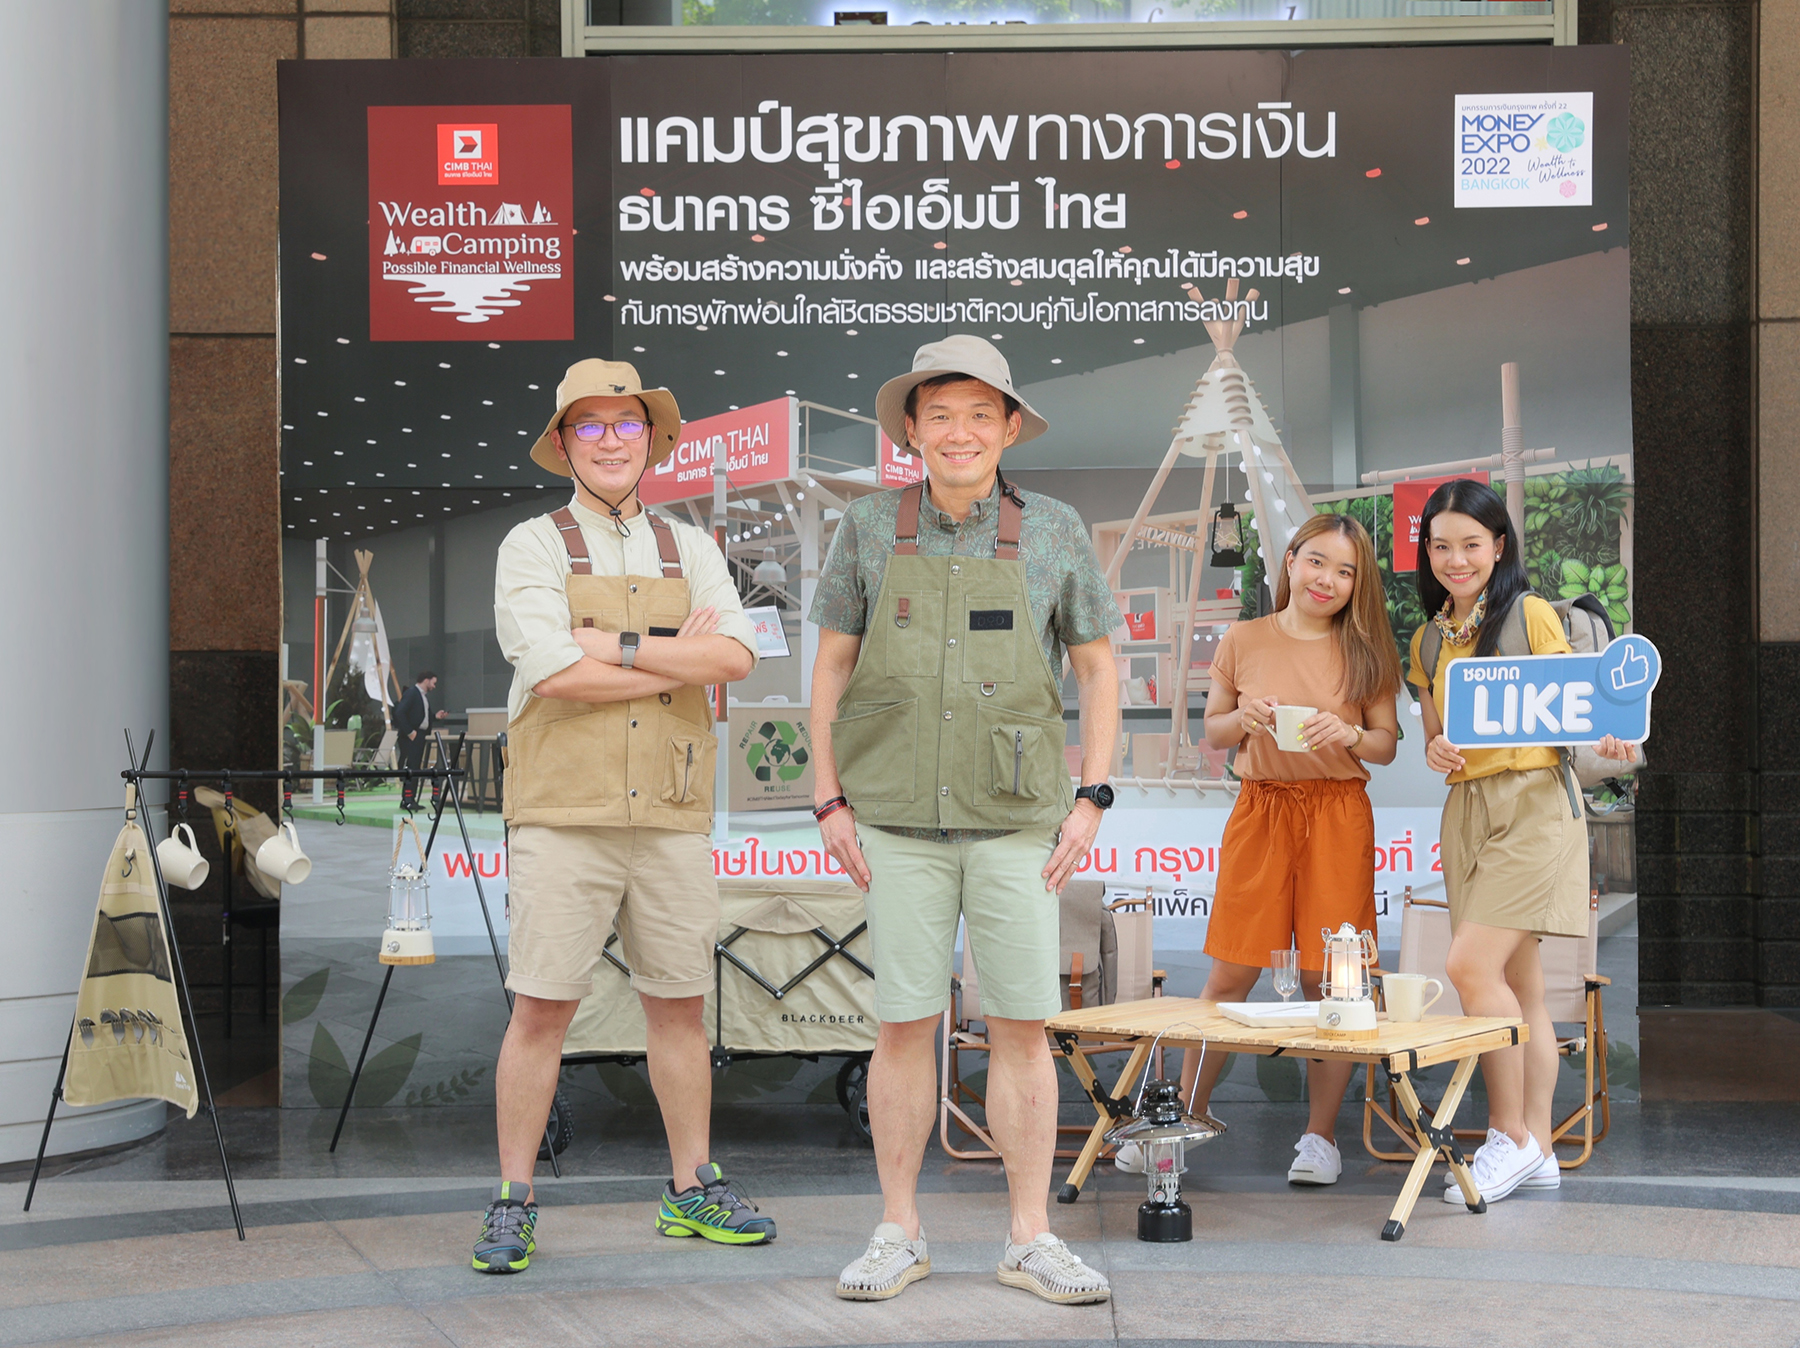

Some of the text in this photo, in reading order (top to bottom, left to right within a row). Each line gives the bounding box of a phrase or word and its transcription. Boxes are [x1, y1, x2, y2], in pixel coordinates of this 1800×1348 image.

[1462, 113, 1545, 132] MONEY
[620, 100, 1336, 180] แคมป์สุขภาพทางการเงิน
[1461, 133, 1531, 153] EXPO
[444, 162, 493, 171] CIMB THAI
[1461, 157, 1510, 175] 2022
[1528, 154, 1577, 172] Wealth to
[1461, 178, 1530, 190] BANGKOK
[1538, 168, 1587, 183] Wellness
[619, 177, 1126, 231] ธนาคาร ซีไอเอ็มบี ไทย
[378, 201, 487, 227] Wealth
[442, 232, 561, 260] Camping
[382, 260, 562, 274] Possible Financial Wellness
[620, 248, 903, 281] พร้อมสร้างความมั่งคั่ง
[727, 422, 769, 453] THAI
[677, 466, 707, 482] ธนาคาร
[750, 450, 769, 467] ไทย
[885, 463, 904, 476] CIMB
[904, 467, 920, 479] THAI
[1463, 666, 1521, 682] ชอบกด
[1473, 681, 1595, 736] LIKE
[739, 720, 813, 753] REPAIR REDUC
[764, 784, 791, 792] REUSE
[781, 1013, 864, 1024] BLACKDEER
